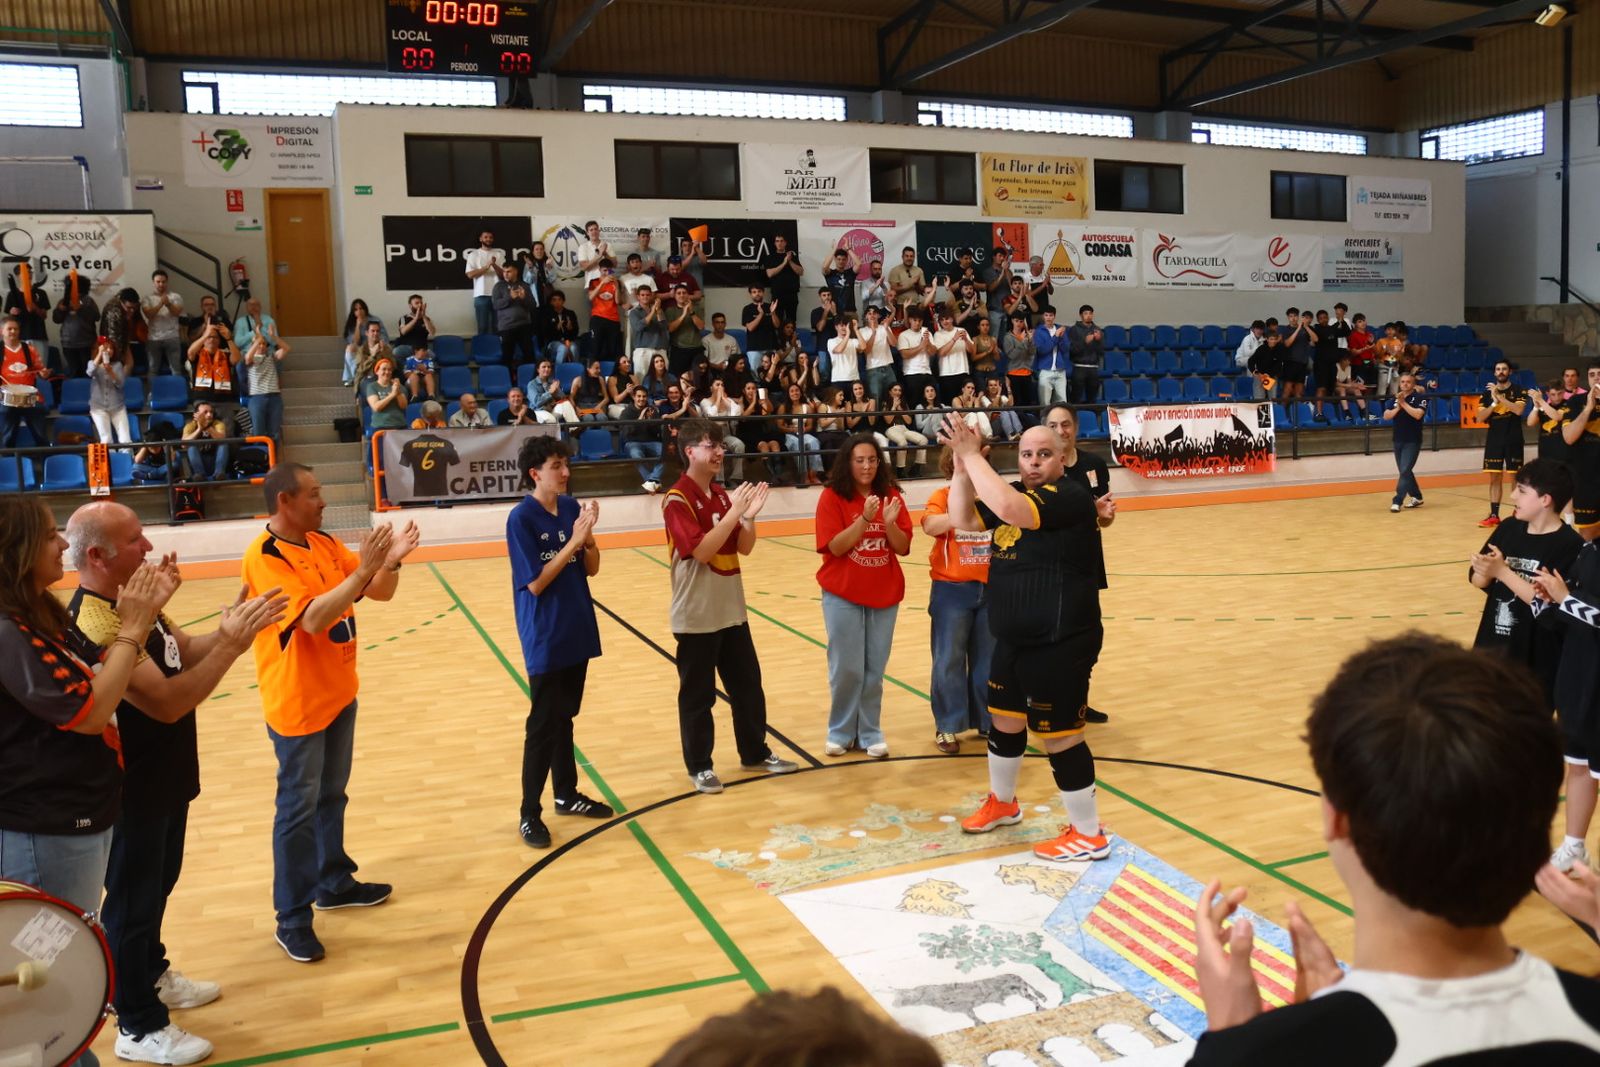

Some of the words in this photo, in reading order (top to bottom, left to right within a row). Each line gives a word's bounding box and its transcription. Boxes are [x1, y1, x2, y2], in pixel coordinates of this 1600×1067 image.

[426, 1, 498, 26] 00:00
[391, 29, 433, 42] LOCAL
[491, 34, 529, 46] VISITANTE
[402, 47, 434, 70] 00
[500, 52, 531, 73] 00
[450, 62, 478, 72] PERIODO
[276, 136, 314, 146] DIGITAL
[992, 159, 1005, 172] La
[1010, 160, 1034, 173] Flor
[1038, 161, 1051, 174] de
[1055, 162, 1076, 175] Iris
[787, 177, 836, 189] MATI
[1370, 192, 1391, 200] TEJADA
[45, 230, 106, 241] ASESORÍA
[1082, 234, 1135, 243] AUTOESCUELA
[1344, 239, 1381, 248] RECICLAJES
[1085, 243, 1133, 257] CODASA
[1345, 250, 1379, 259] MONTALVO
[1164, 256, 1228, 266] TARDAGUILA
[1194, 408, 1213, 419] SOMOS
[422, 449, 435, 471] 6
[469, 459, 519, 473] ETERN
[1147, 469, 1187, 478] SALAMANCA
[1189, 467, 1214, 475] NUNCA
[450, 475, 535, 496] CAPITA
